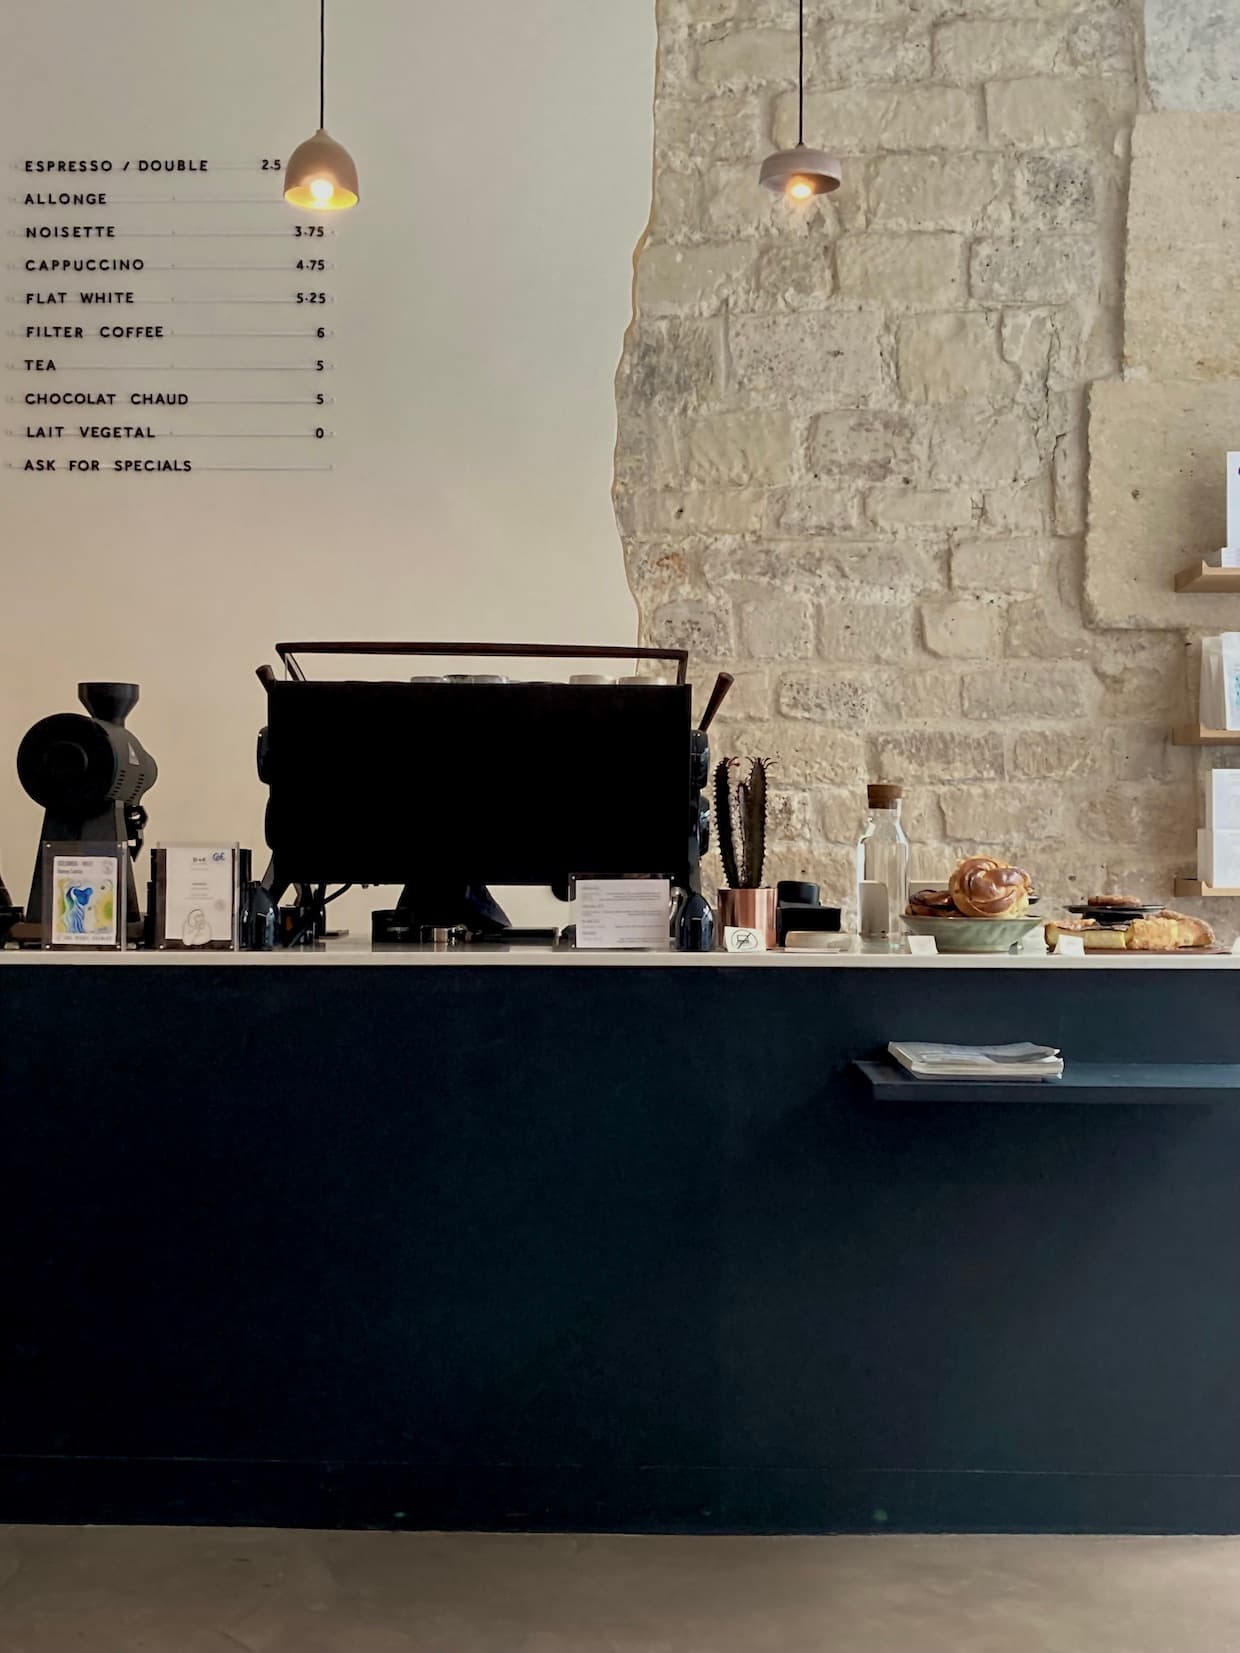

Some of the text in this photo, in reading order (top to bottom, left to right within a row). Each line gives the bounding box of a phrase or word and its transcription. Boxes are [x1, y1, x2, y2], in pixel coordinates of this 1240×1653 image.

[24, 159, 113, 173] ESPRESSO
[122, 160, 131, 173] /
[137, 159, 209, 173] DOUBLE
[23, 192, 107, 206] ALLONGE
[25, 225, 325, 239] NOISETTE 3.75
[24, 258, 326, 272] CAPPUCCINO 4.75
[25, 291, 327, 305] FLAT WHITE 5.25
[25, 325, 326, 339] FILTER COFFEE 6
[23, 359, 325, 372] TEA 5
[24, 392, 325, 406] CHOCOLAT CHAUD 5
[25, 426, 65, 439] LAIT
[79, 425, 156, 439] VEGETAL
[23, 458, 192, 473] ASK FOR SPECIALS
